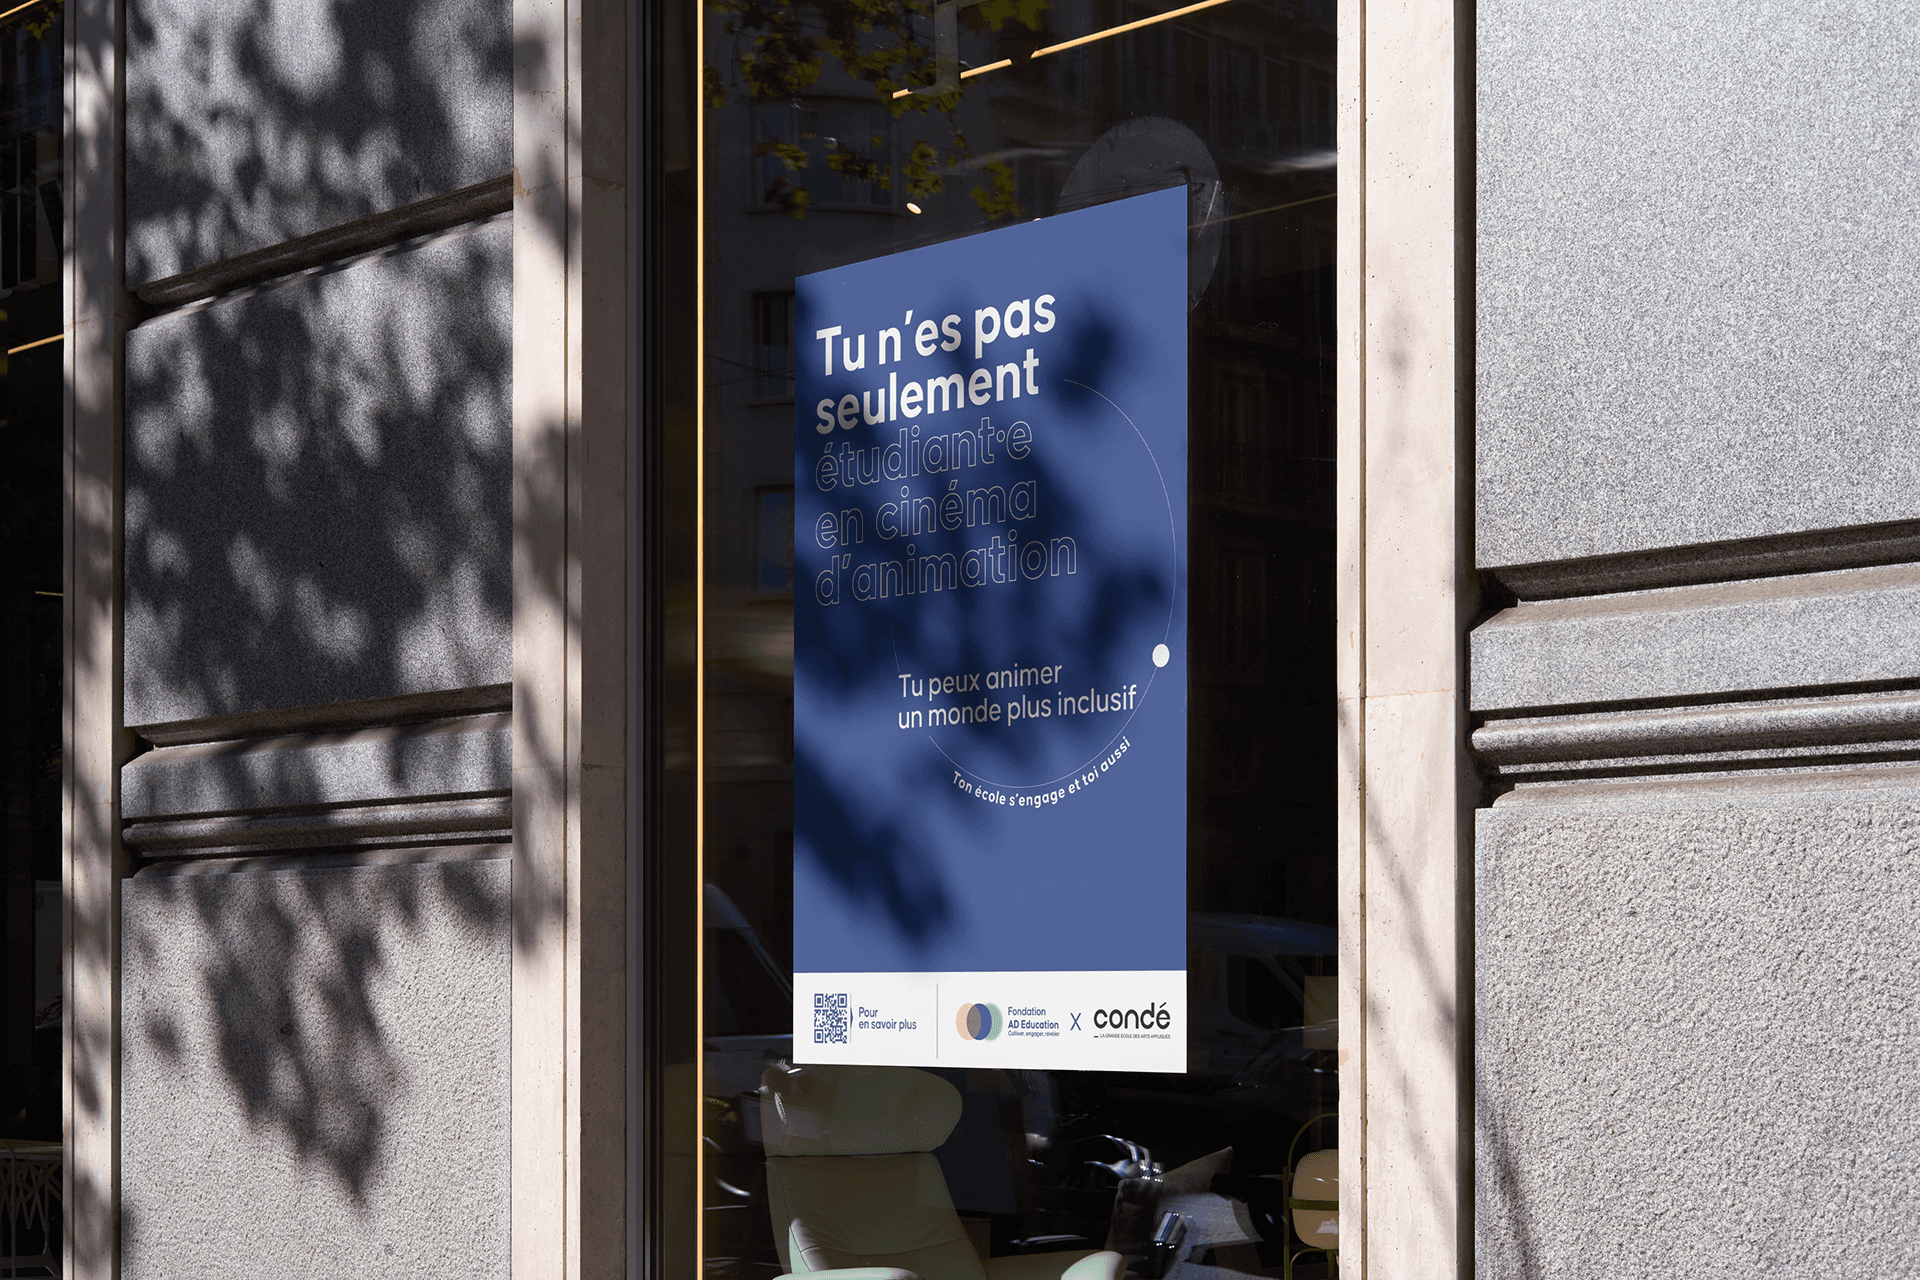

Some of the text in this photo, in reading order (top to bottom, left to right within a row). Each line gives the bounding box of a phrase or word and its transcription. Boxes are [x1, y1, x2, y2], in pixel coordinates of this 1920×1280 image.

[816, 294, 1056, 376] Tu n'es pas
[816, 348, 1039, 434] seulement
[815, 479, 1037, 549] en cinéma
[815, 529, 1077, 606] d'animation
[899, 663, 1062, 701] Tu peux animer
[899, 684, 1137, 729] un monde plus inclusif
[952, 736, 1131, 808] Ton école s'engage et toi aussi
[858, 1006, 878, 1018] Pour
[858, 1018, 917, 1032] en savoir plus
[1007, 1006, 1047, 1017] Fondation
[1007, 1019, 1060, 1030] AD Education
[1093, 1002, 1171, 1031] condé
